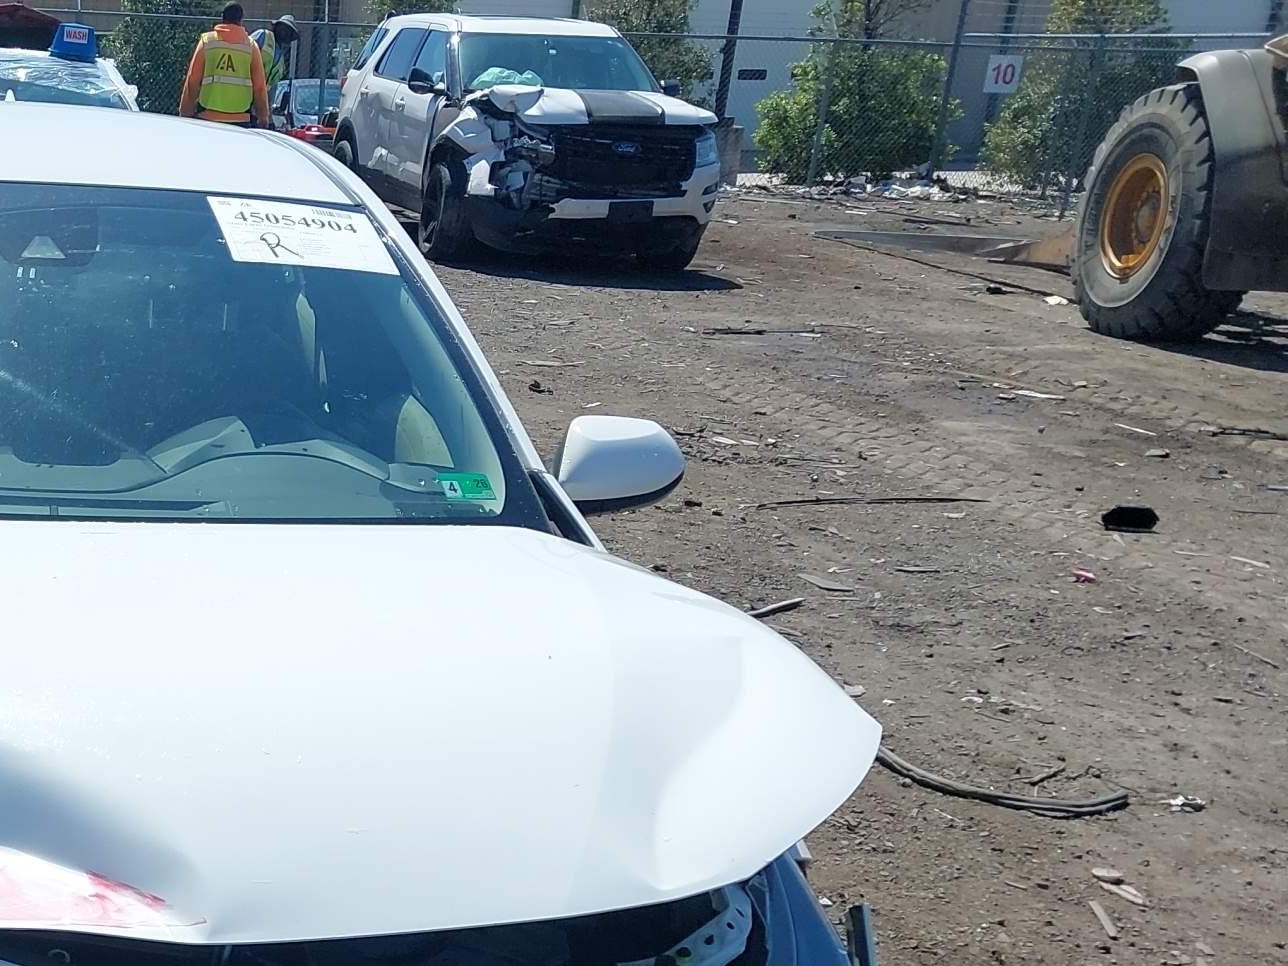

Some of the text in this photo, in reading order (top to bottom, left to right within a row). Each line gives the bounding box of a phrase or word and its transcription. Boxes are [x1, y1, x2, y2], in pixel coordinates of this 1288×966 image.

[65, 29, 87, 41] WASH
[992, 63, 1016, 85] 10
[233, 210, 358, 234] 45054904
[259, 231, 305, 260] R
[448, 481, 458, 494] 4
